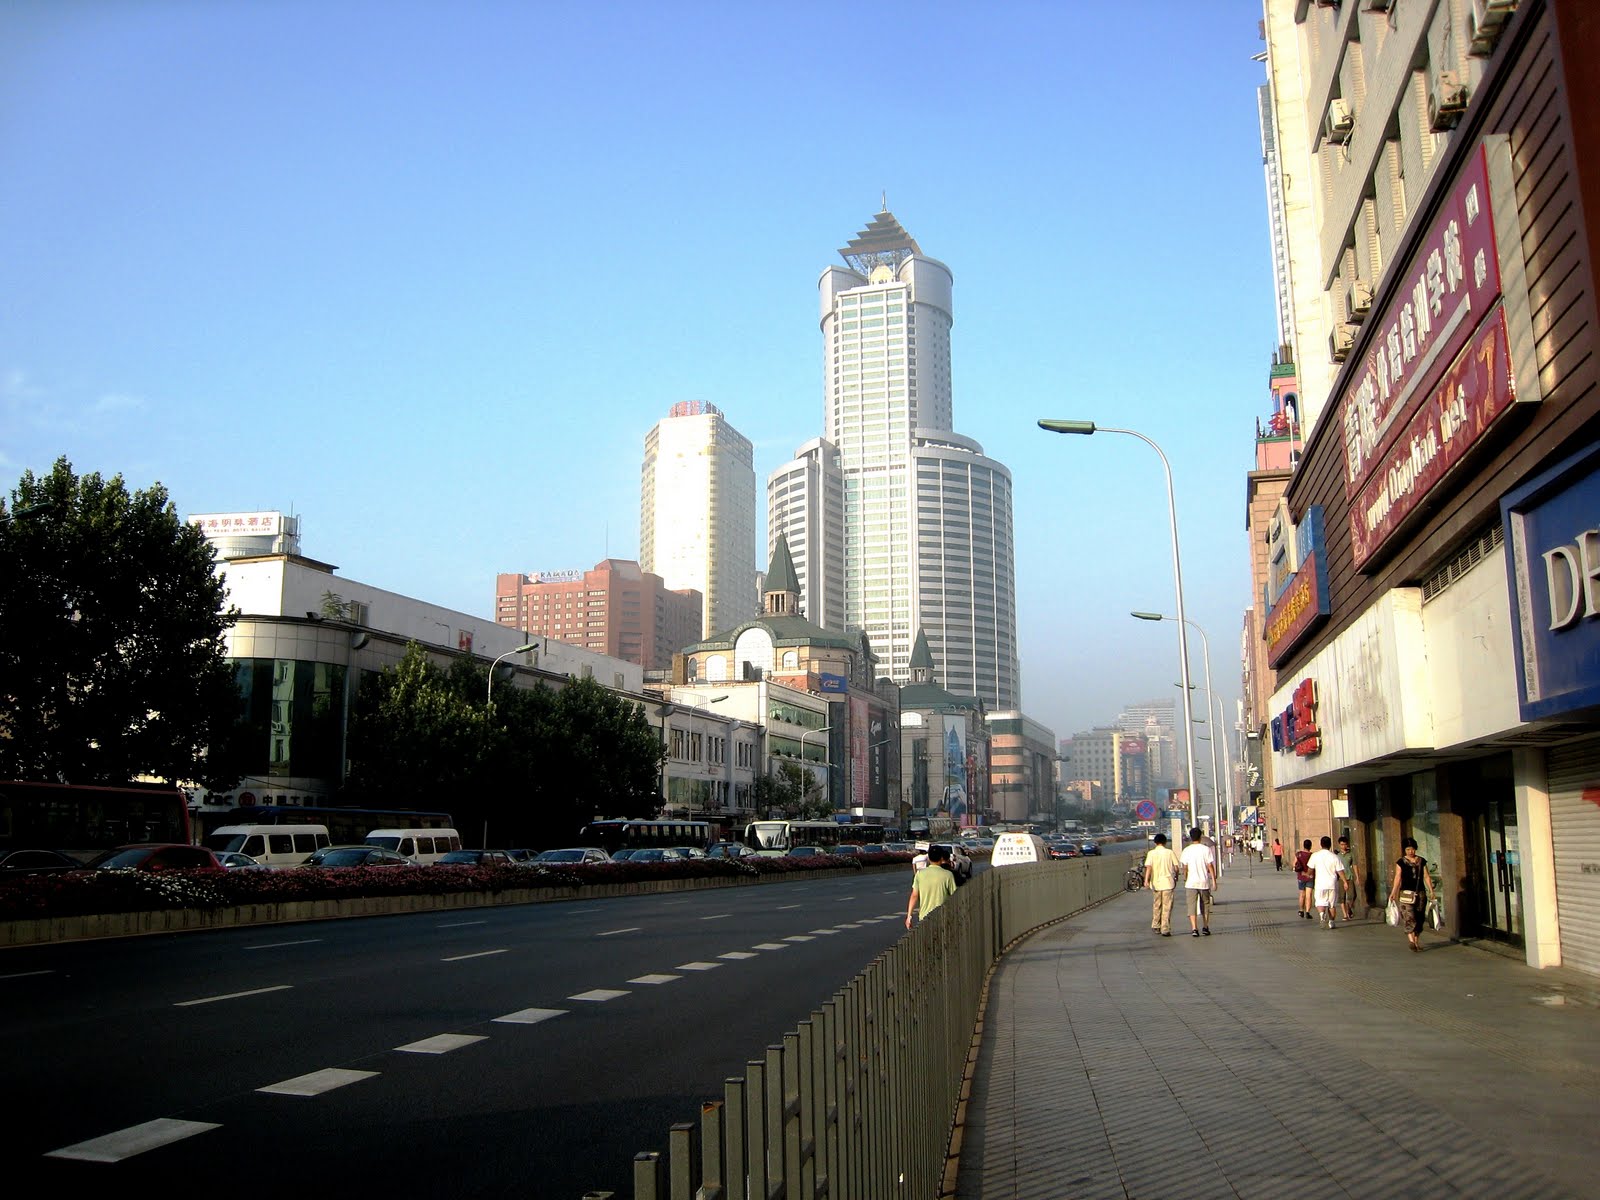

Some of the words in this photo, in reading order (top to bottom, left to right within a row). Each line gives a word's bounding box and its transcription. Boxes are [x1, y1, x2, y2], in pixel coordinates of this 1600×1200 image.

[1344, 219, 1463, 484] 青联外语培训学校
